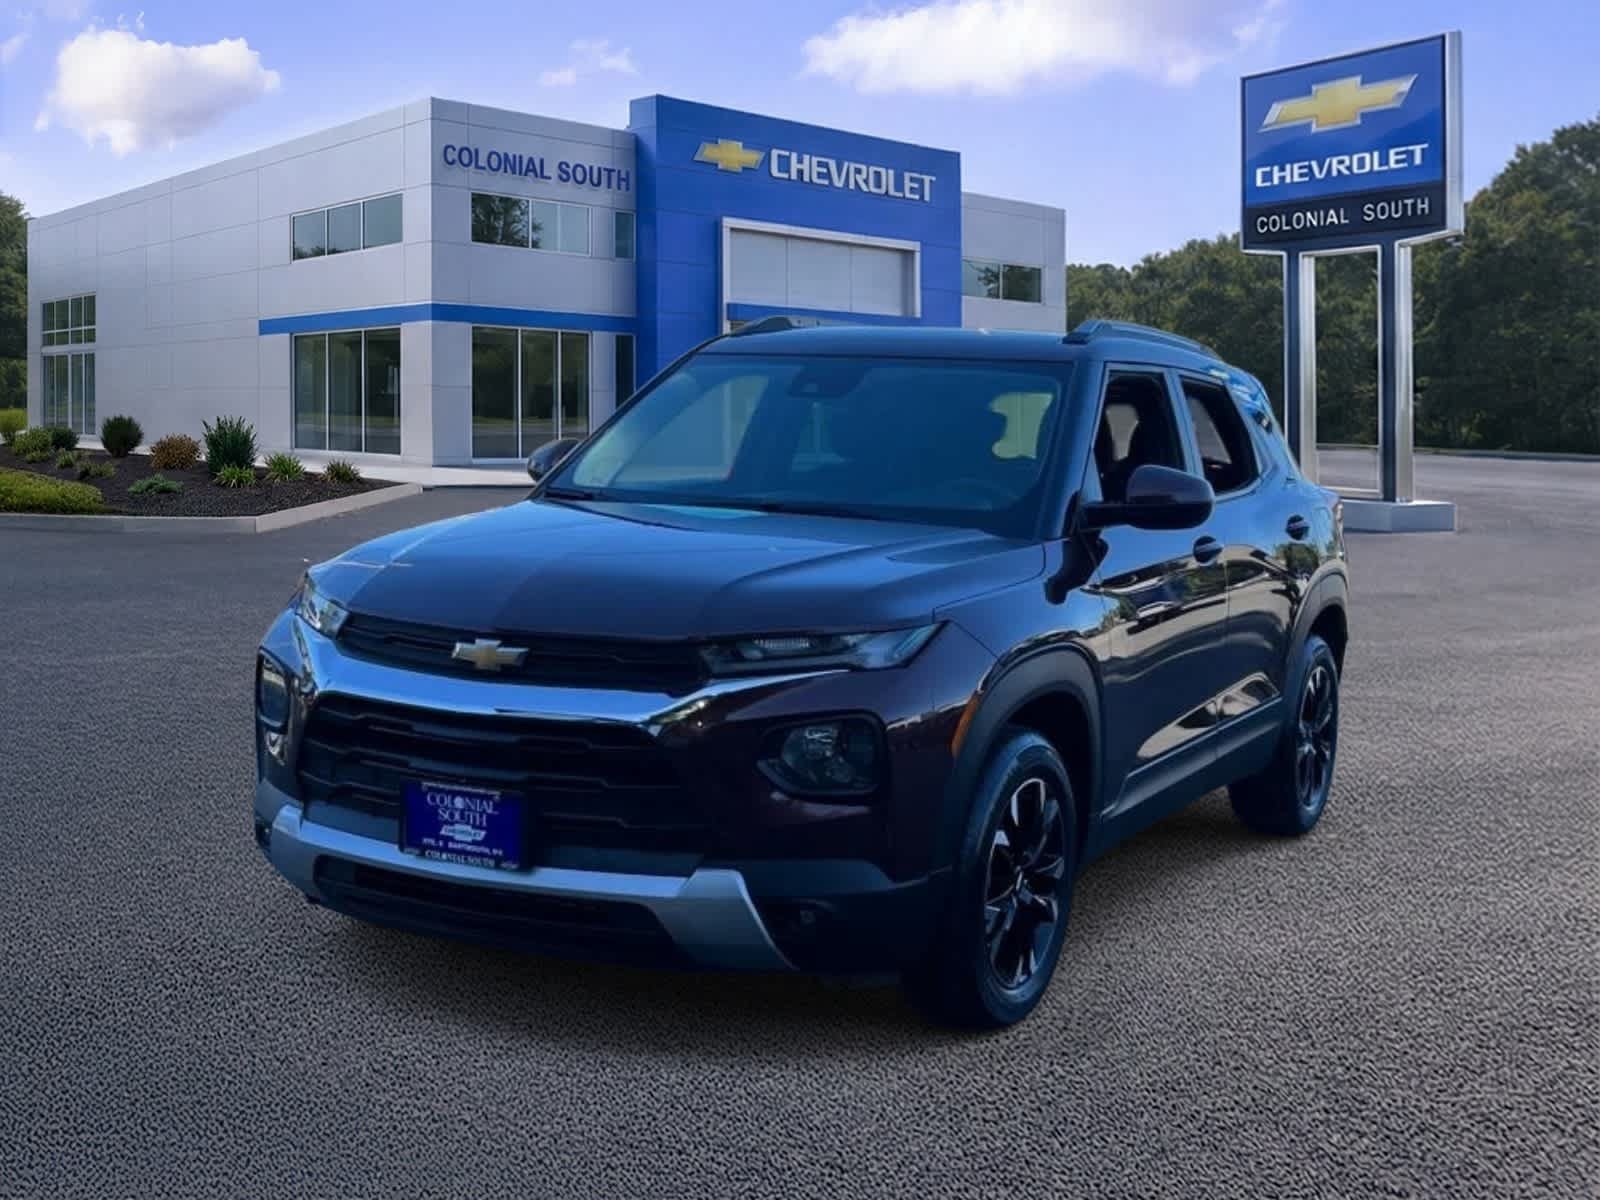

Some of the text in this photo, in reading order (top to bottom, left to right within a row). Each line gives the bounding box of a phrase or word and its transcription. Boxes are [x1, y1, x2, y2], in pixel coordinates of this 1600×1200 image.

[443, 144, 631, 192] COLONIAL SOUTH
[770, 148, 936, 202] CHEVROLET
[1255, 143, 1429, 187] CHEVROLET
[1256, 197, 1430, 234] COLONIAL SOUTH
[426, 792, 499, 815] COLONIAL
[437, 808, 487, 827] SOUTH
